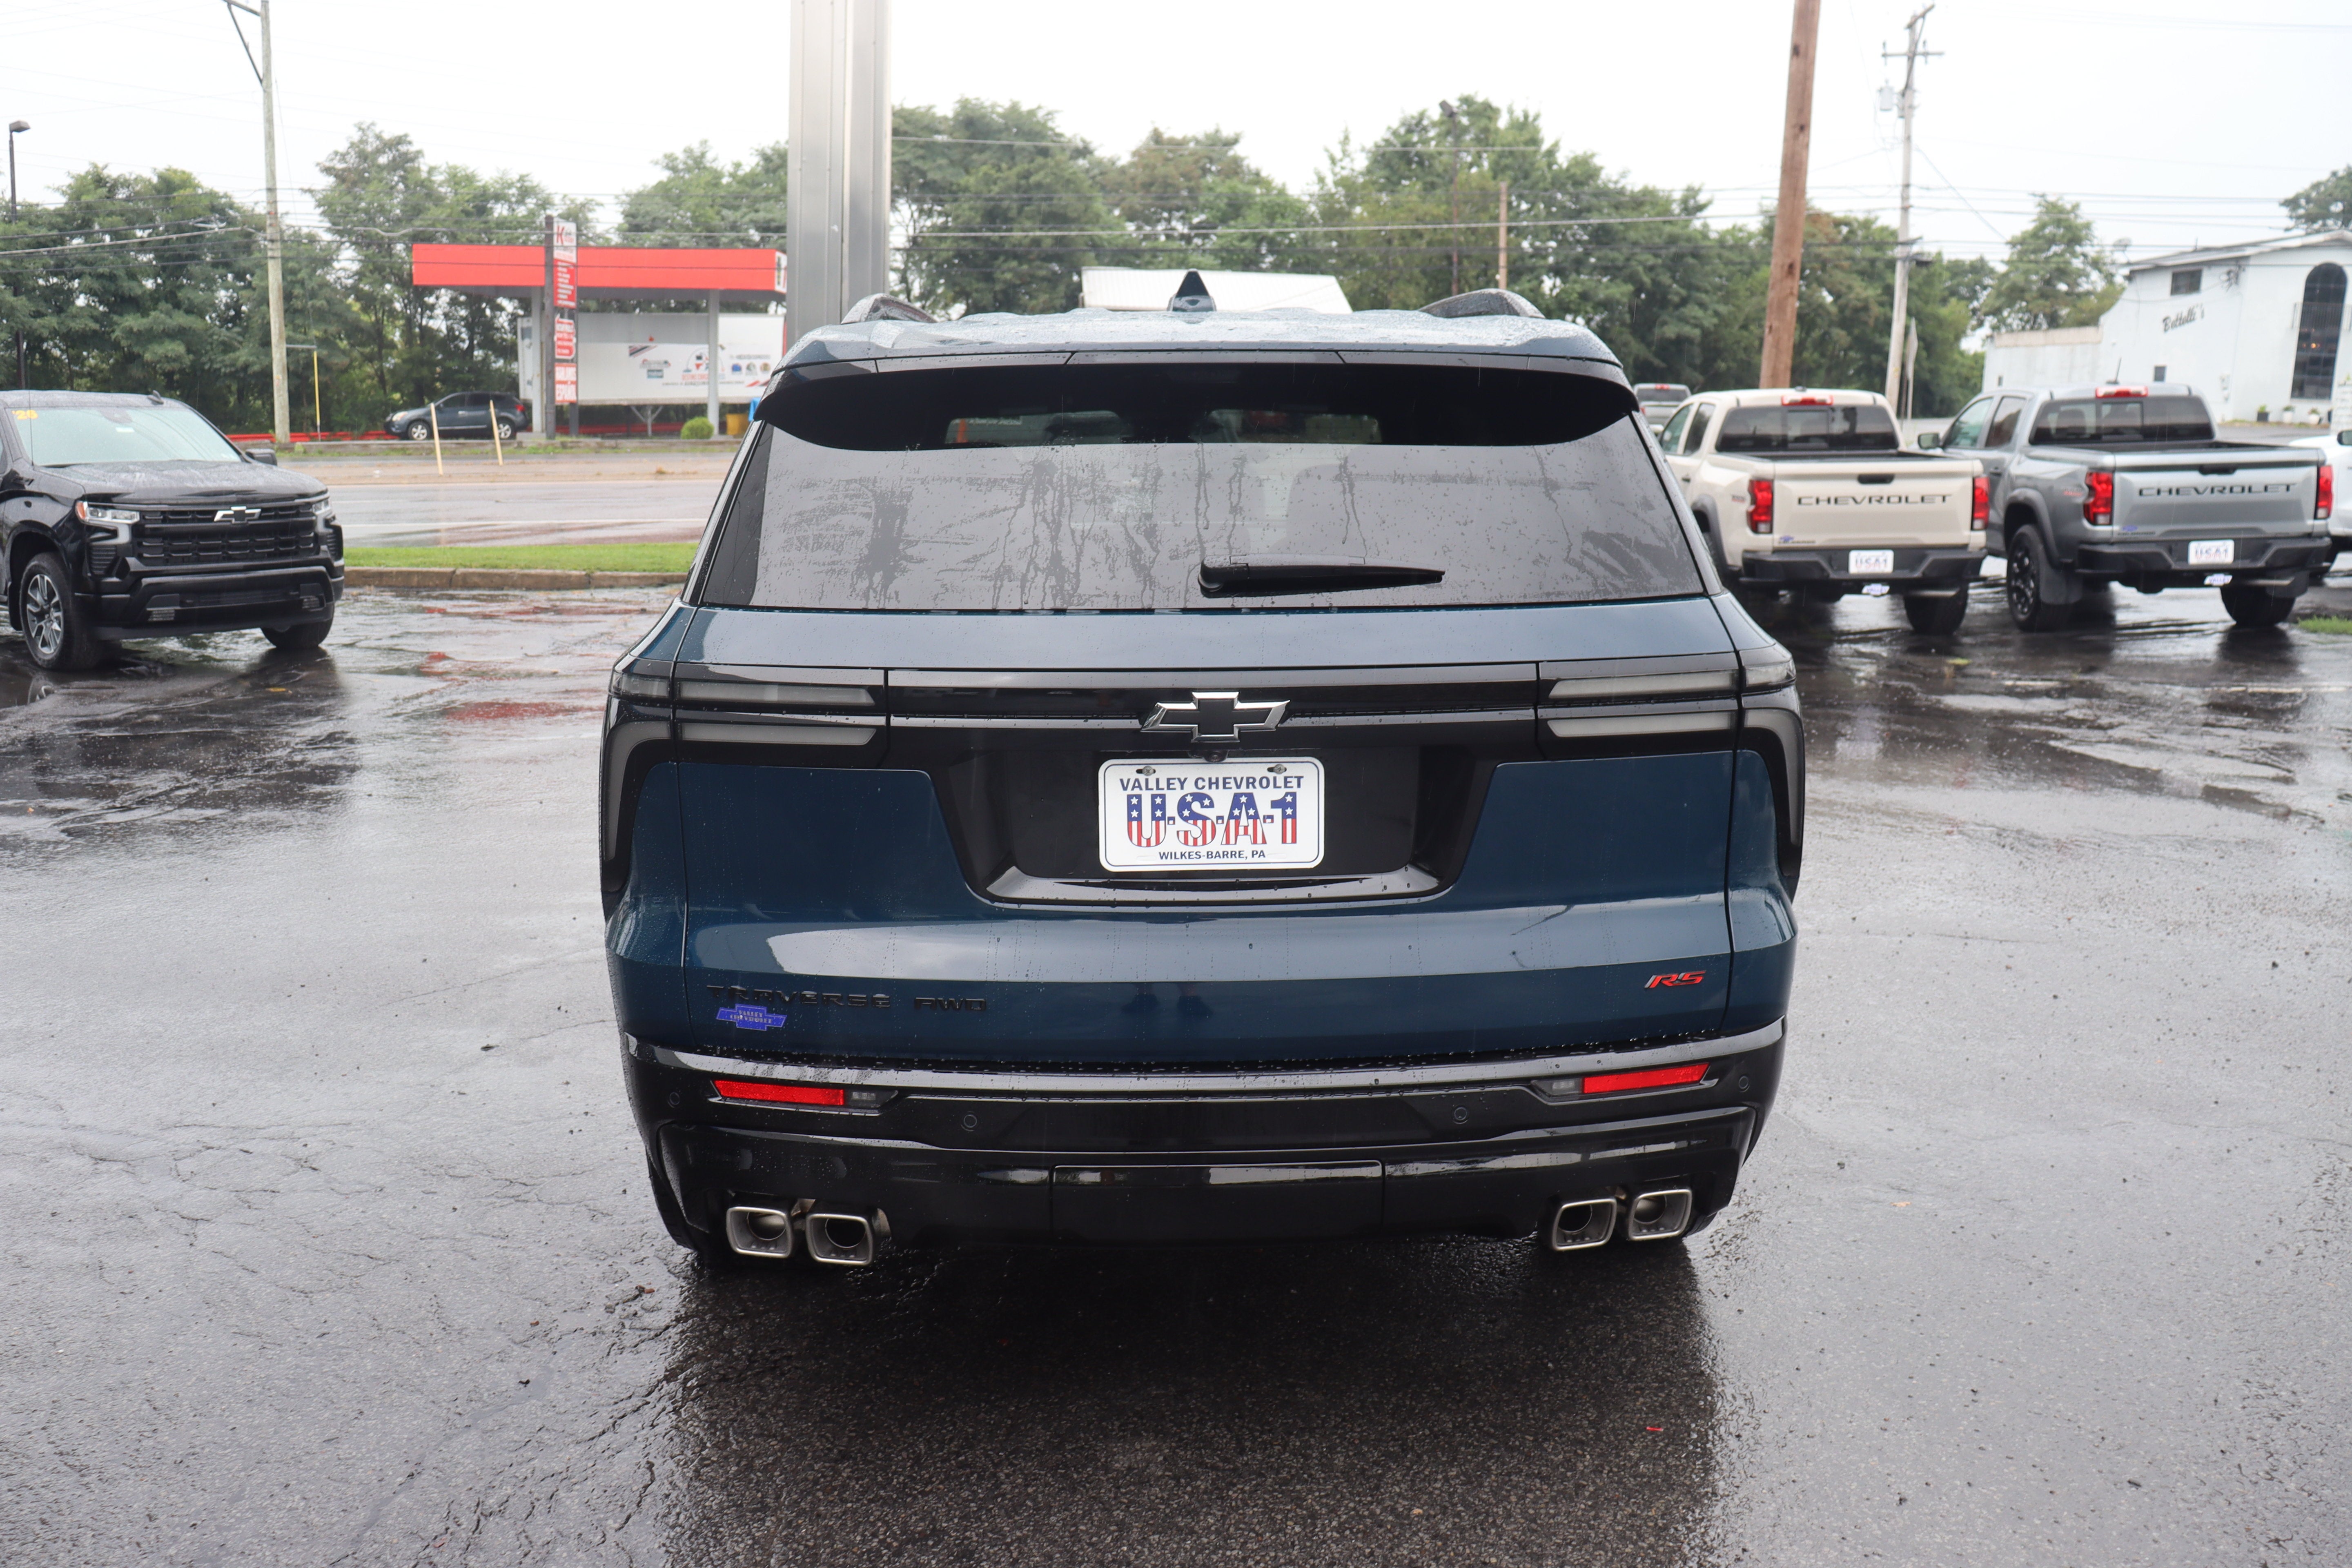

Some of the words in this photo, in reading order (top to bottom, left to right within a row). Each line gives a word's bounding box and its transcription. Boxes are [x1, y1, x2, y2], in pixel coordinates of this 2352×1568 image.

[2138, 483, 2296, 496] CHEVROLET
[1798, 494, 1952, 506] CHEVROLET
[1120, 777, 1188, 791] VALLEY
[1194, 775, 1304, 790] CHEVROLET
[1159, 851, 1247, 860] WILKES-BARRE,
[1251, 850, 1266, 858] PA
[1644, 970, 1706, 988] RS
[706, 985, 891, 1008] TRAVERSE
[913, 997, 987, 1011] AWD
